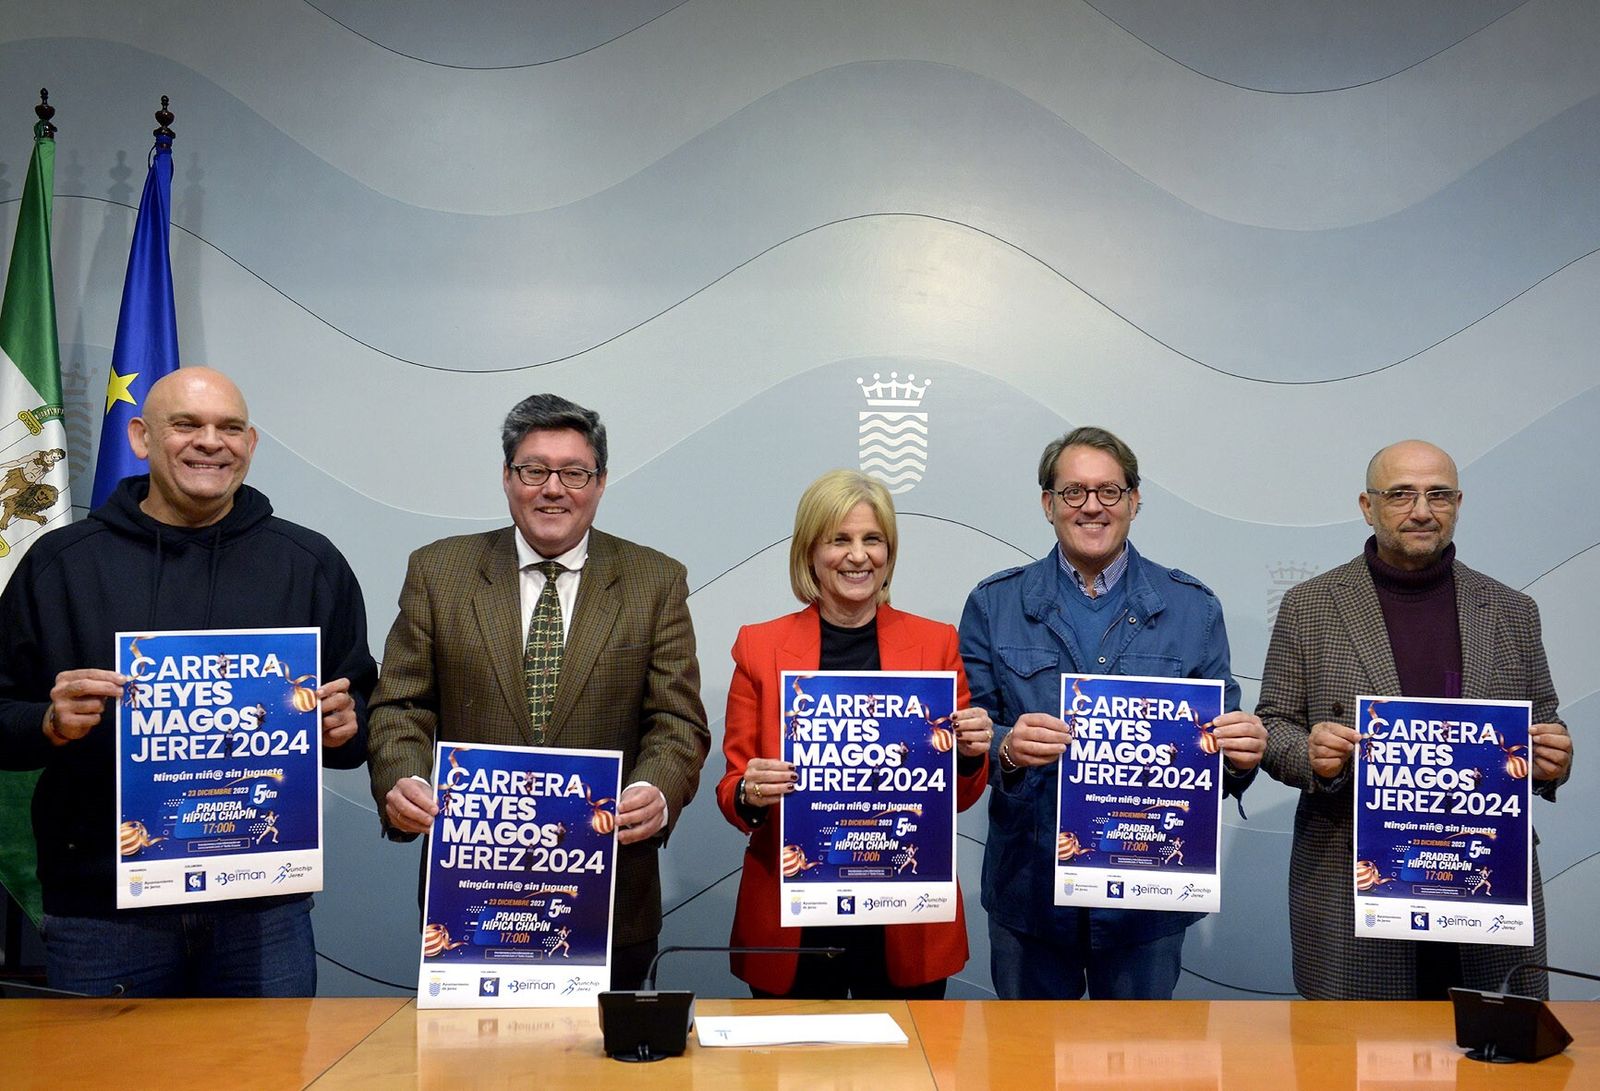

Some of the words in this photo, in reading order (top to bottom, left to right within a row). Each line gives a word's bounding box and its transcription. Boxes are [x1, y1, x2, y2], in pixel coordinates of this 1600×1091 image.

[130, 653, 284, 681] CARRERA
[132, 681, 233, 708] REYES
[793, 694, 925, 718] CARRERA
[1072, 694, 1194, 722] CARRERA
[131, 706, 258, 735] MAGOS
[793, 718, 880, 742] REYES
[1071, 717, 1151, 742] REYES
[1367, 718, 1499, 745] CARRERA
[131, 734, 225, 762] JEREZ
[232, 730, 310, 757] 2024
[1070, 740, 1171, 766] MAGOS
[793, 742, 901, 767] MAGOS
[1367, 742, 1453, 767] REYES
[153, 770, 193, 783] Ningún
[195, 769, 223, 780] niñ@
[225, 770, 241, 779] sin
[243, 768, 283, 779] juguete
[447, 767, 585, 798] CARRERA
[794, 768, 872, 792] JEREZ
[878, 767, 946, 792] 2024
[1069, 762, 1142, 787] JEREZ
[1148, 766, 1212, 791] 2024
[1367, 764, 1475, 791] MAGOS
[188, 789, 196, 797] 23
[197, 788, 232, 796] DICIEMBRE
[197, 801, 242, 813] PRADERA
[446, 792, 536, 821] REYES
[811, 802, 845, 812] Ningún
[847, 802, 870, 812] niñ@
[872, 802, 886, 811] sin
[887, 802, 922, 812] juguete
[1085, 794, 1117, 803] Ningún
[1118, 794, 1141, 805] niñ@
[1142, 797, 1155, 806] sin
[1156, 798, 1189, 807] juguete
[1366, 789, 1445, 813] JEREZ
[1451, 792, 1521, 817] 2024
[182, 811, 217, 823] HÍPICA
[219, 807, 256, 821] CHAPÍN
[1119, 811, 1147, 819] DICIEMBRE
[203, 822, 235, 835] 17:00h
[442, 819, 558, 847] MAGOS
[1118, 823, 1155, 833] PRADERA
[1384, 821, 1418, 832] Ningún
[1419, 823, 1443, 833] niñ@
[1445, 824, 1460, 833] sin
[1461, 825, 1497, 835] juguete
[847, 832, 886, 841] PRADERA
[1106, 830, 1134, 841] HÍPICA
[1136, 831, 1166, 842] CHAPÍN
[1421, 839, 1450, 847] DICIEMBRE
[835, 839, 864, 850] HÍPICA
[866, 839, 899, 850] CHAPÍN
[1122, 841, 1149, 852] 17:00h
[440, 845, 525, 871] JEREZ
[532, 848, 605, 874] 2024
[852, 851, 880, 862] 17:00h
[1420, 852, 1459, 862] PRADERA
[1408, 859, 1437, 869] HÍPICA
[1439, 860, 1472, 871] CHAPÍN
[1425, 871, 1453, 881] 17:00h
[459, 880, 495, 891] Ningún
[497, 881, 523, 891] niñ@
[524, 883, 540, 891] sin
[540, 883, 578, 893] juguete
[496, 912, 538, 922] PRADERA
[482, 920, 514, 931] HÍPICA
[516, 920, 551, 932] CHAPÍN
[500, 932, 529, 943] 17:00h
